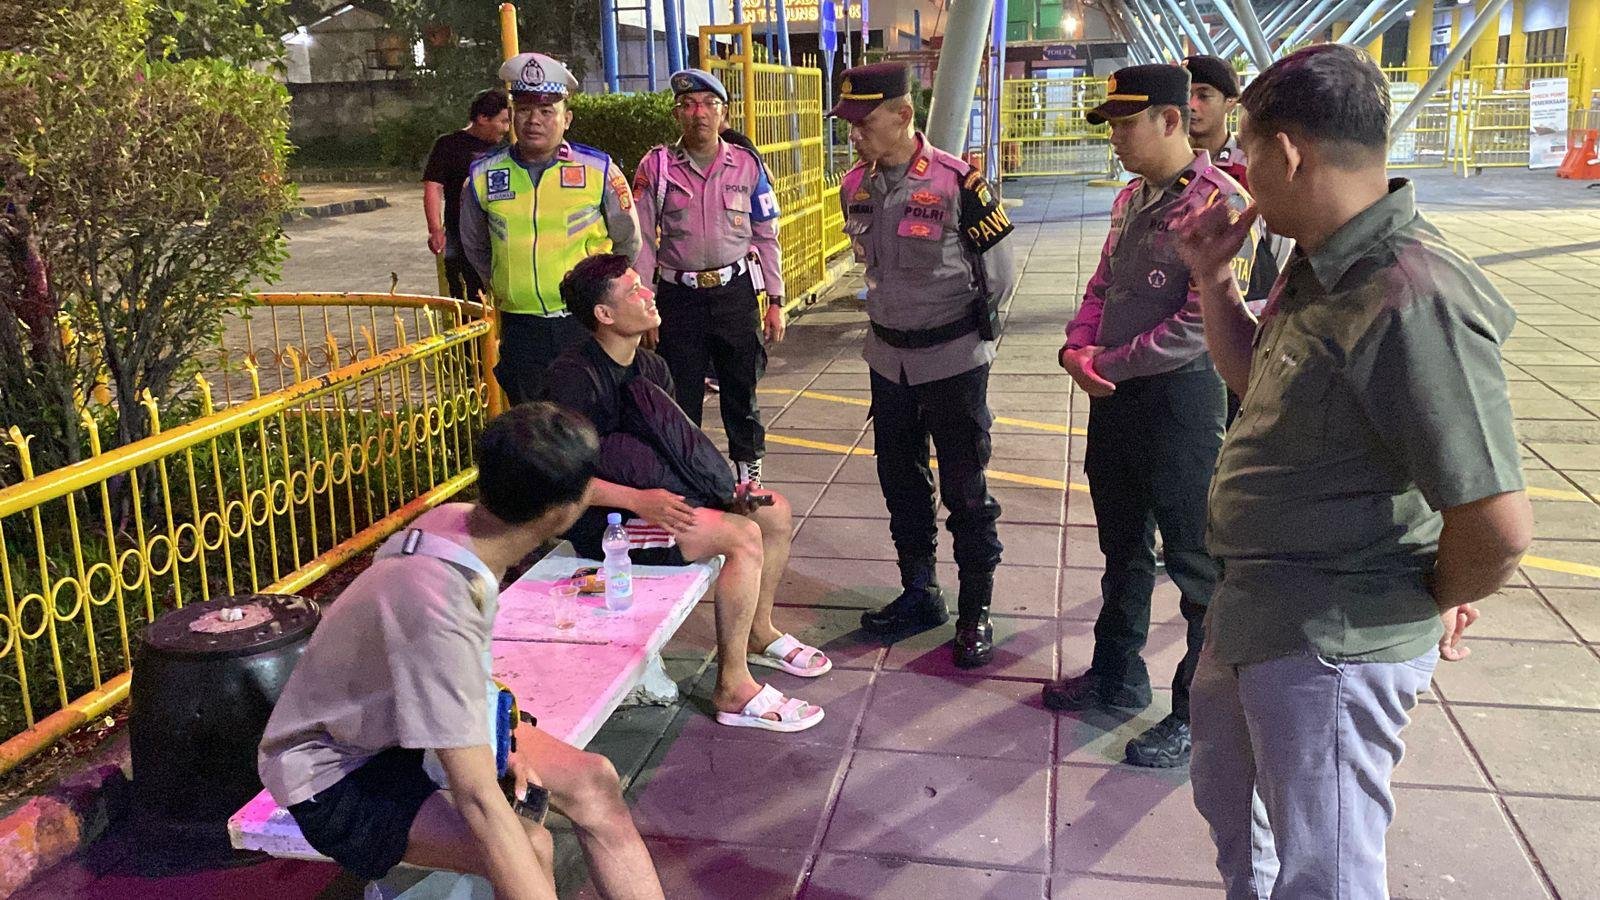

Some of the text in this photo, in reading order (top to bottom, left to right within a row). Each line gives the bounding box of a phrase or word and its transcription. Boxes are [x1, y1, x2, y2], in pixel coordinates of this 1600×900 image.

[726, 184, 748, 193] POLRI
[904, 206, 944, 220] POLRI
[967, 203, 1011, 247] PAW
[1150, 219, 1172, 232] POL
